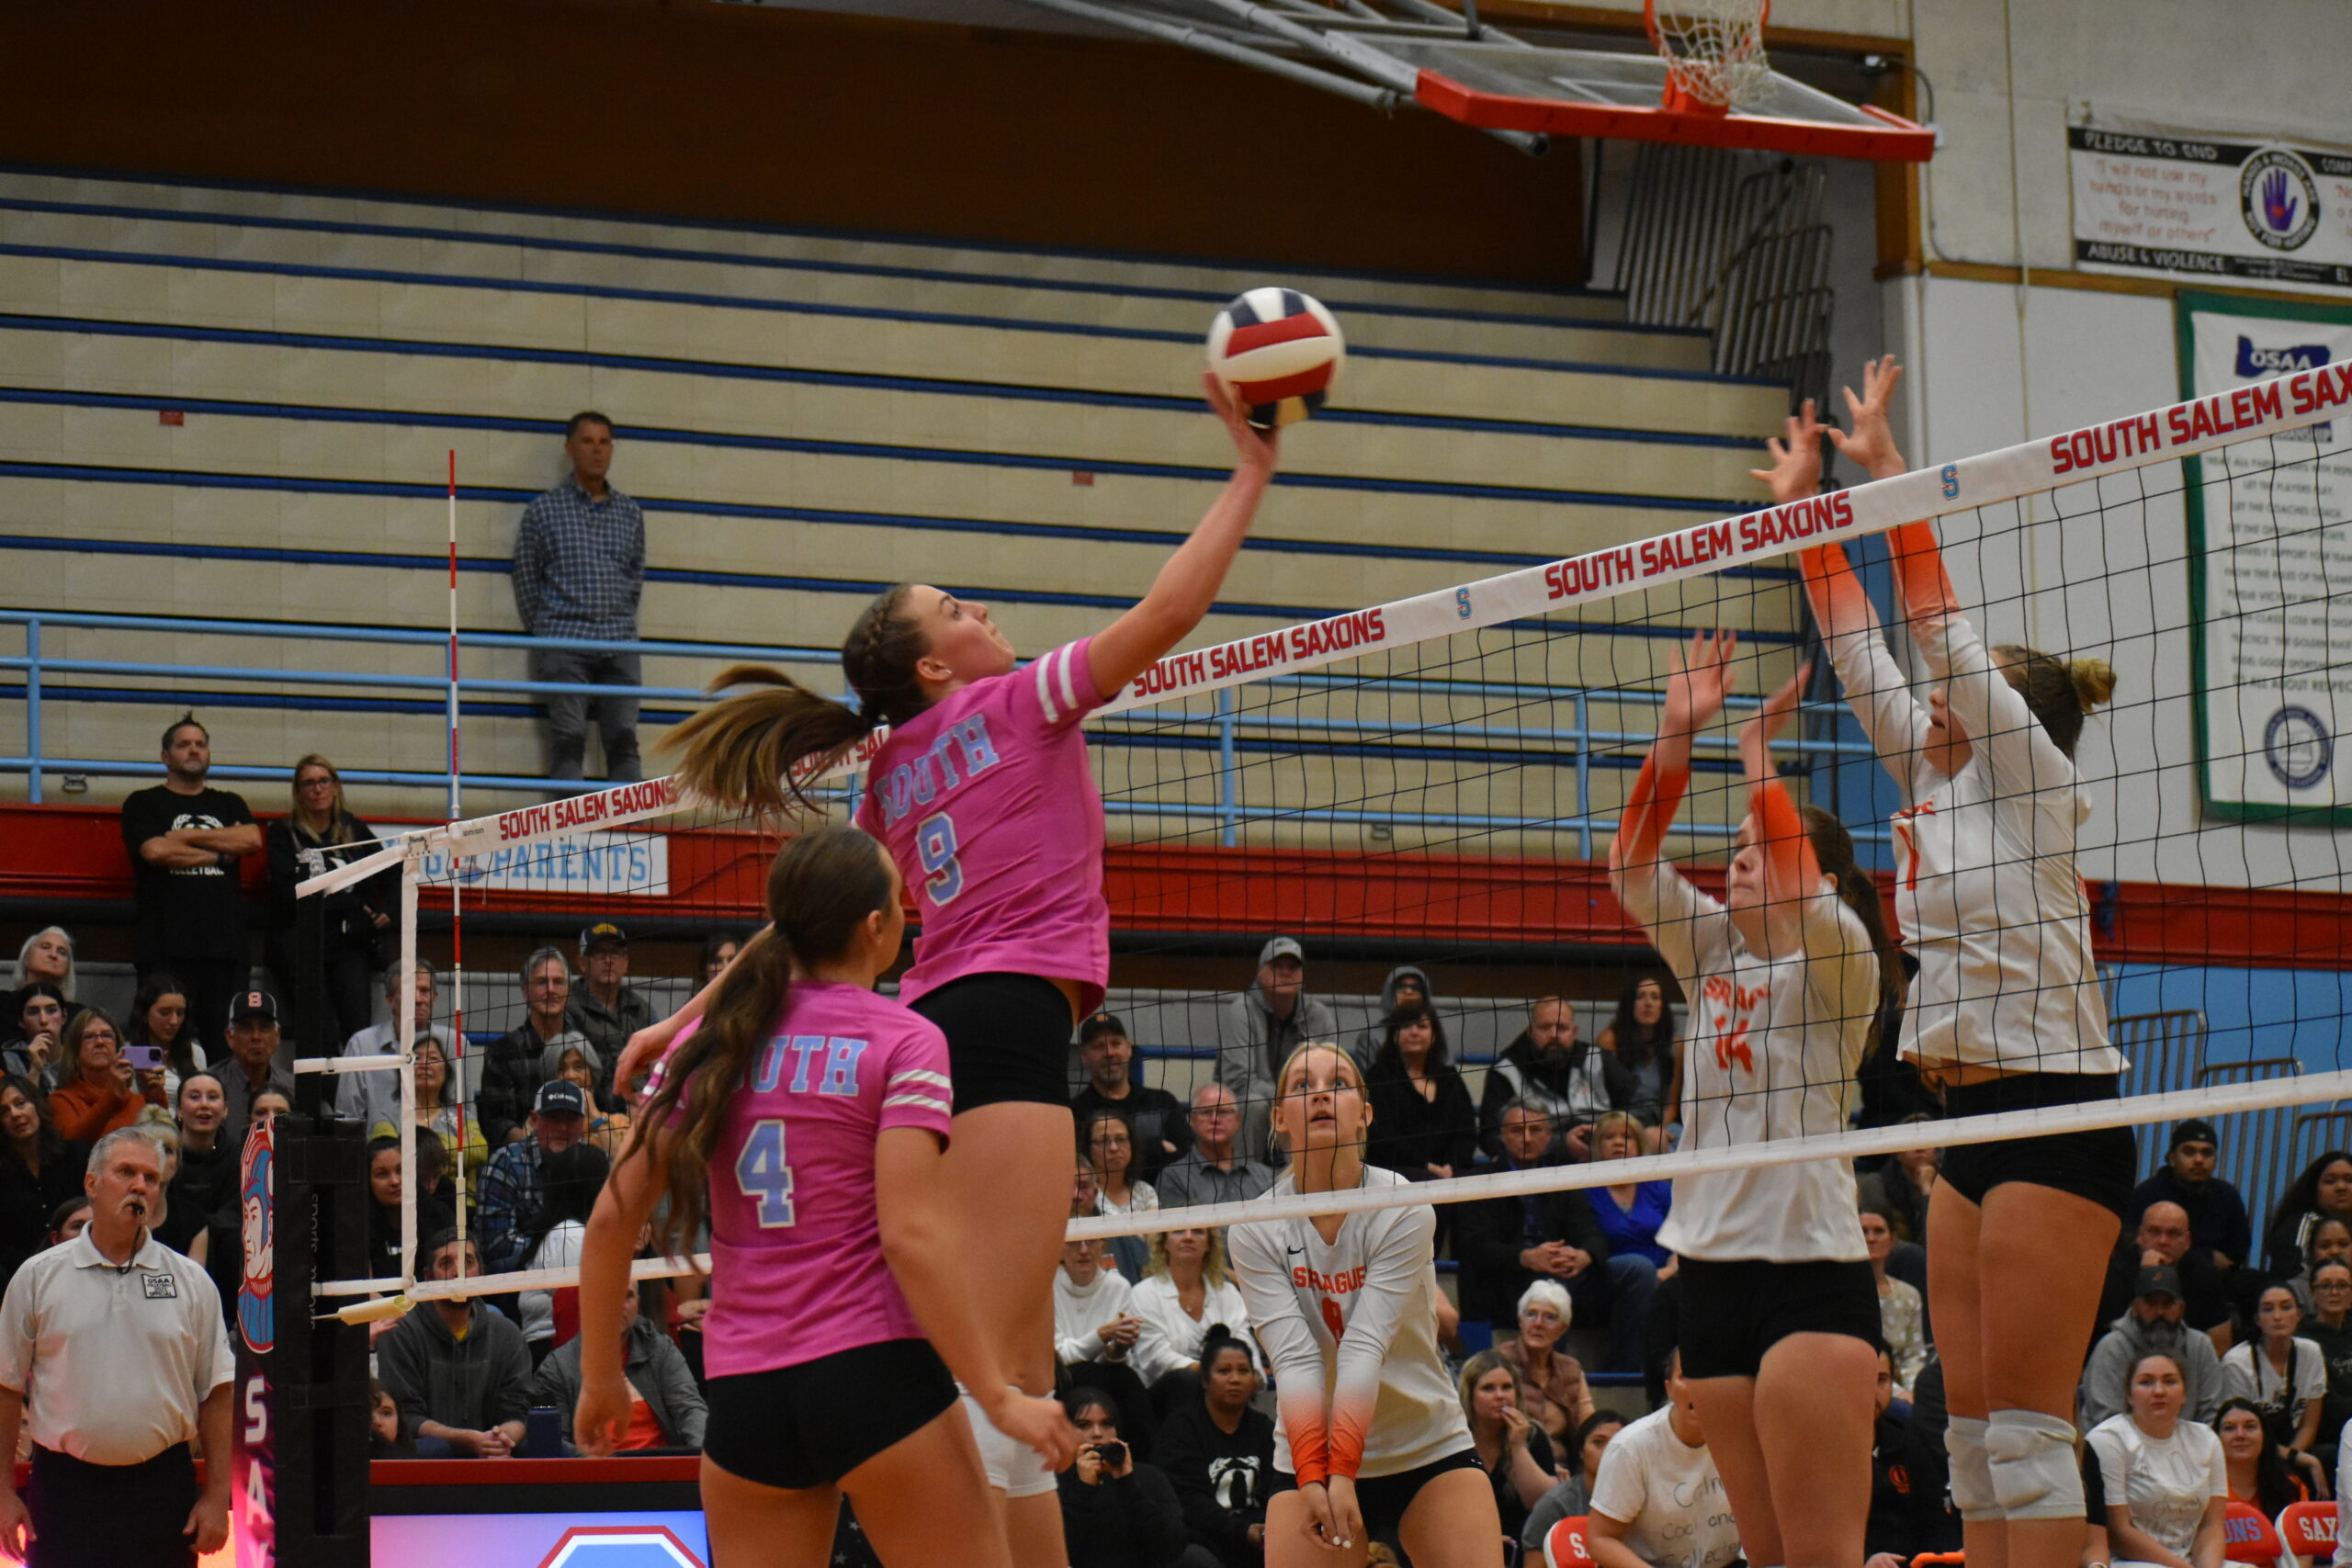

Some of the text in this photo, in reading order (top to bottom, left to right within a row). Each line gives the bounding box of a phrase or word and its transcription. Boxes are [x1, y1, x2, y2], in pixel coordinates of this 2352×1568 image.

[2085, 130, 2219, 161] PLEDGE TO END
[2087, 243, 2136, 263] ABUSE
[2153, 251, 2225, 273] VIOLENCE
[2252, 351, 2312, 369] OSAA
[2051, 412, 2162, 475] SOUTH
[2168, 381, 2284, 446] SALEM
[1940, 462, 1961, 501] S
[1544, 490, 1854, 601] SOUTH SALEM SAXONS
[1456, 586, 1472, 620] S
[1133, 607, 1386, 699] SOUTH SALEM SAXONS
[873, 714, 1001, 831] SOUTH
[500, 776, 677, 840] SOUTH SALEM SAXONS
[915, 811, 964, 907] 9
[747, 1034, 868, 1097] UTH
[735, 1119, 797, 1228] 4
